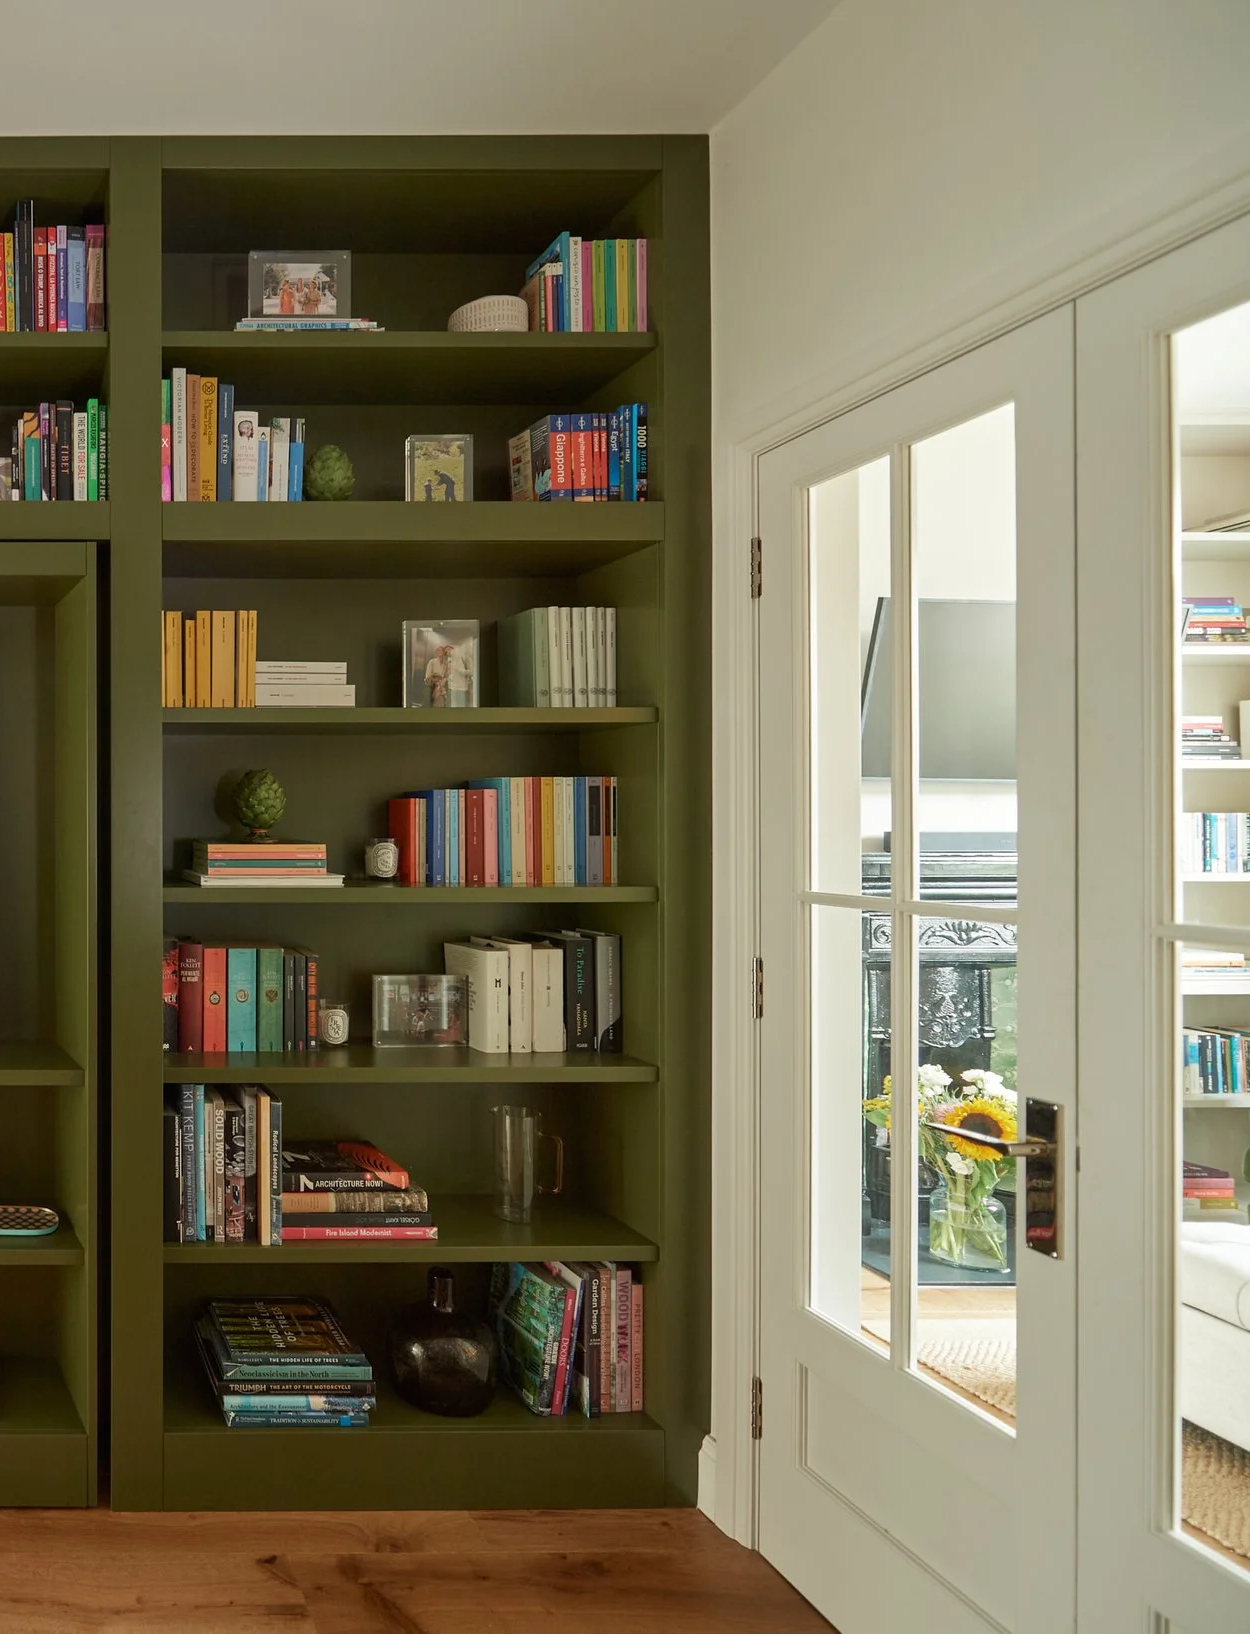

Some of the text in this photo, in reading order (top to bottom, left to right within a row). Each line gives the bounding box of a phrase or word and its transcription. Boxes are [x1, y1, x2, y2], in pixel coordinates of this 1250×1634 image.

[191, 431, 197, 440] TO
[578, 432, 587, 462] Inghilterra
[610, 431, 619, 452] Egypt
[637, 425, 647, 448] 1000
[61, 444, 69, 475] TIBET
[555, 434, 566, 484] Giappone
[308, 962, 317, 975] CITY
[577, 947, 585, 994] To Paradise
[182, 1091, 194, 1152] KIT KEMP
[215, 1109, 224, 1174] SOLID WOOD
[315, 1180, 383, 1188] ARCHITECTURE NOW!
[590, 1309, 599, 1335] Design
[617, 1281, 629, 1364] WOOD WORK
[545, 1325, 555, 1364] ARCHITECTURE
[551, 1341, 559, 1365] GREEN
[559, 1337, 569, 1366] DOORS
[239, 1369, 330, 1378] Neoclassicism in the North
[229, 1384, 267, 1393] TRIUMPH
